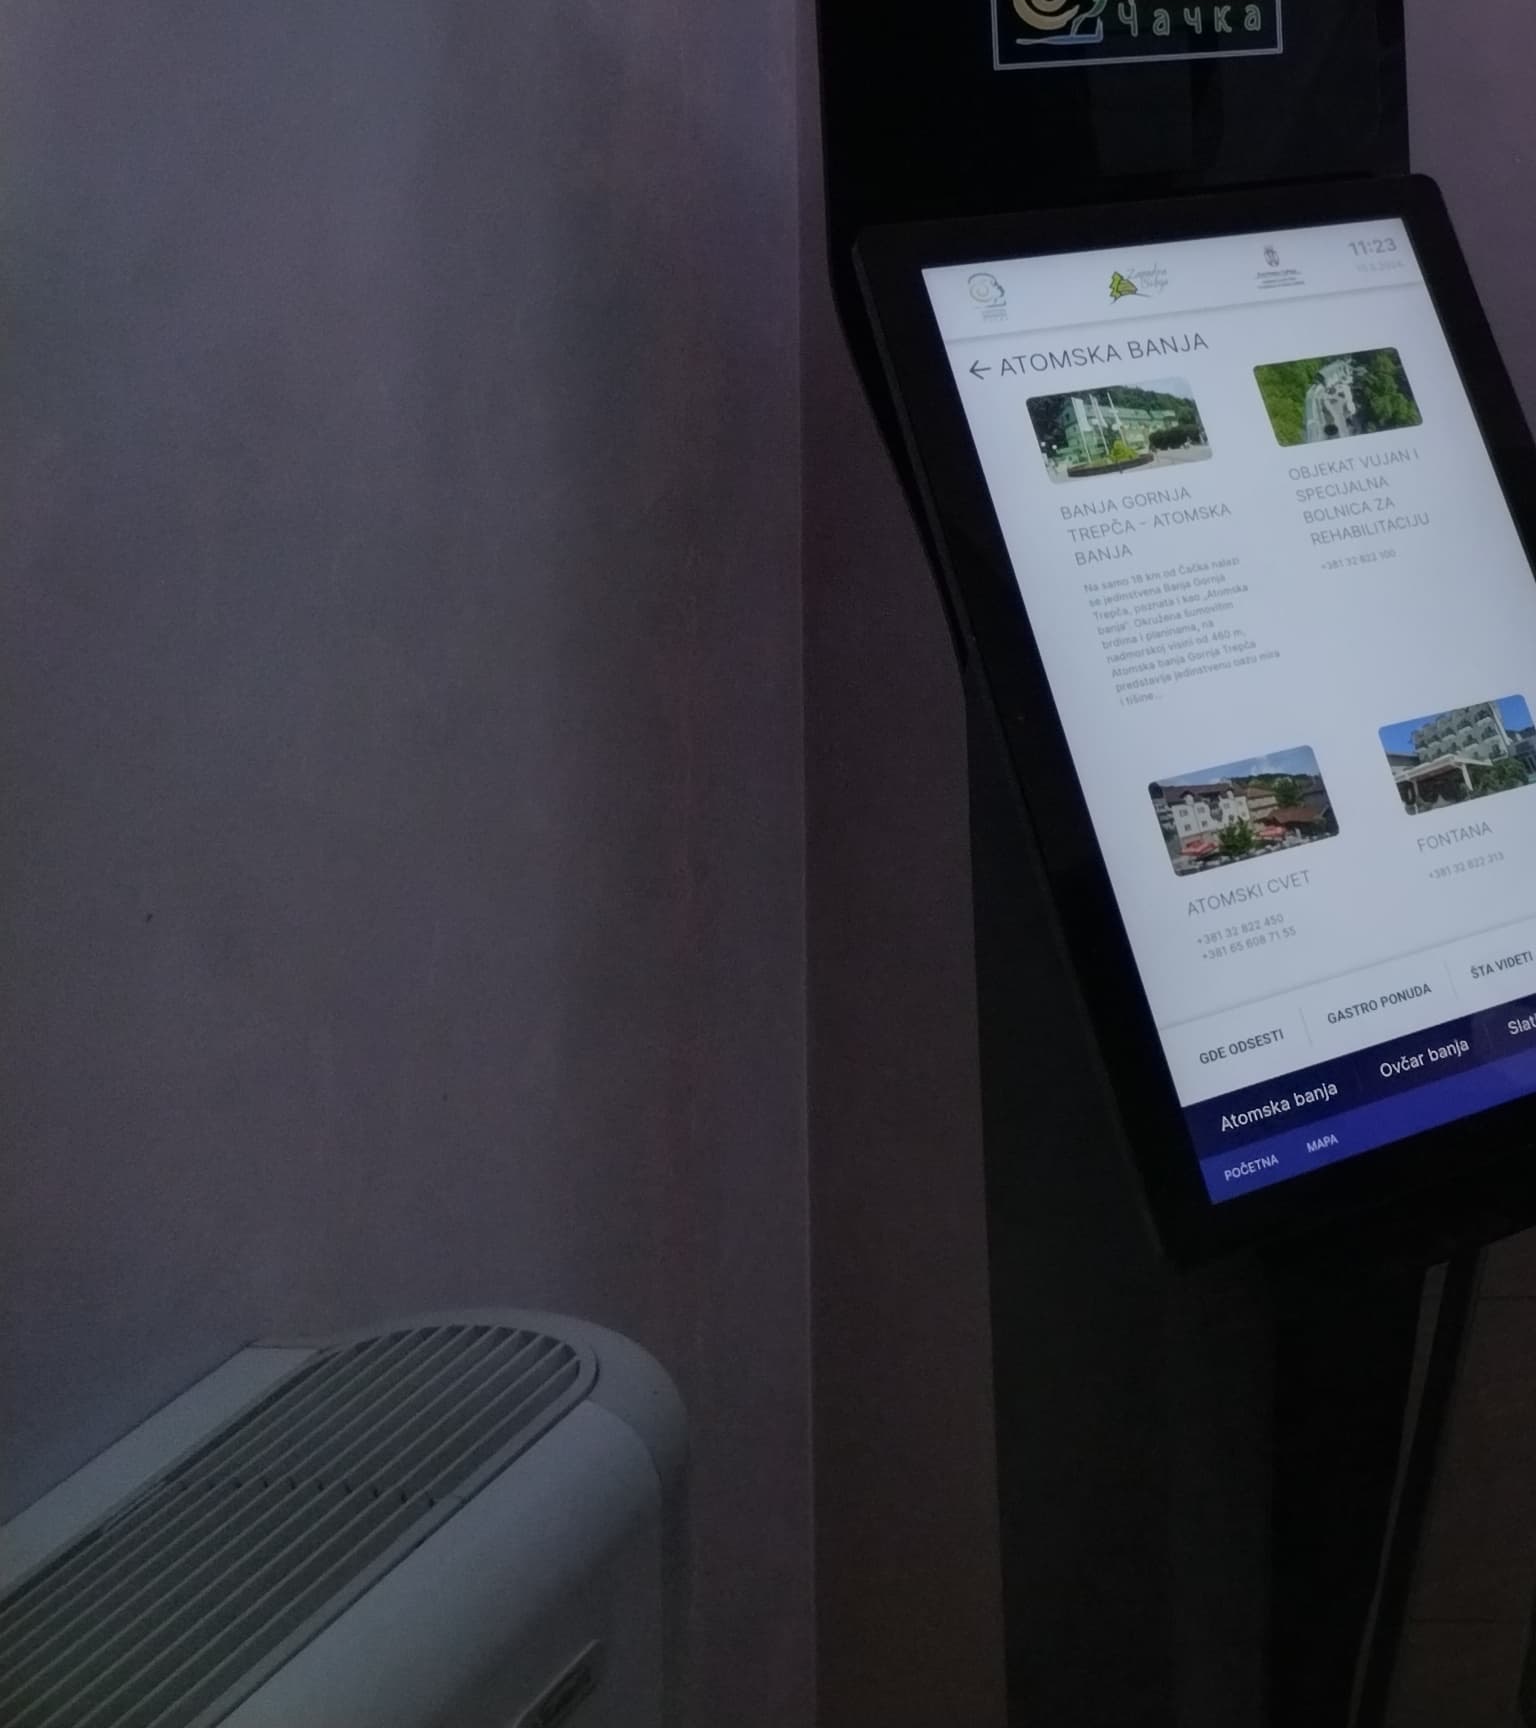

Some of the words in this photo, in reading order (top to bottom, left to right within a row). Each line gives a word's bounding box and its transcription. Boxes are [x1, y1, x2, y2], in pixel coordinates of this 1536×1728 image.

[1347, 236, 1398, 256] 11:23
[995, 342, 1122, 376] ATOMSKA
[1125, 331, 1209, 359] BANJA
[1286, 458, 1357, 481] OBJEKAT
[1358, 448, 1411, 469] VUJAN
[1059, 498, 1118, 520] BANJA
[1120, 485, 1192, 510] GORNJA
[1294, 474, 1390, 503] SPECIJALNA
[1066, 515, 1136, 543] TREPČA
[1149, 501, 1232, 528] ATOMSKA
[1301, 499, 1373, 524] BOLNICA
[1373, 495, 1396, 511] ZA
[1309, 511, 1431, 545] REHABILITACIJU
[1073, 542, 1133, 566] BANJA
[1415, 819, 1494, 853] FONTANA
[1185, 882, 1264, 916] ATOMSKI
[1265, 868, 1313, 894] CVET
[1469, 960, 1495, 979] ŠTA
[1494, 950, 1534, 972] VIDETI
[1325, 998, 1379, 1025] GASTRO
[1379, 982, 1432, 1008] PONUDA
[1198, 1045, 1227, 1065] GDE
[1227, 1027, 1285, 1056] ODSESTI
[1378, 1049, 1426, 1078] Ovčar
[1426, 1036, 1471, 1065] banja
[1218, 1095, 1292, 1132] Atomska
[1292, 1079, 1340, 1111] banja
[1306, 1133, 1339, 1153] MAPA
[1222, 1151, 1279, 1182] POČETNA
